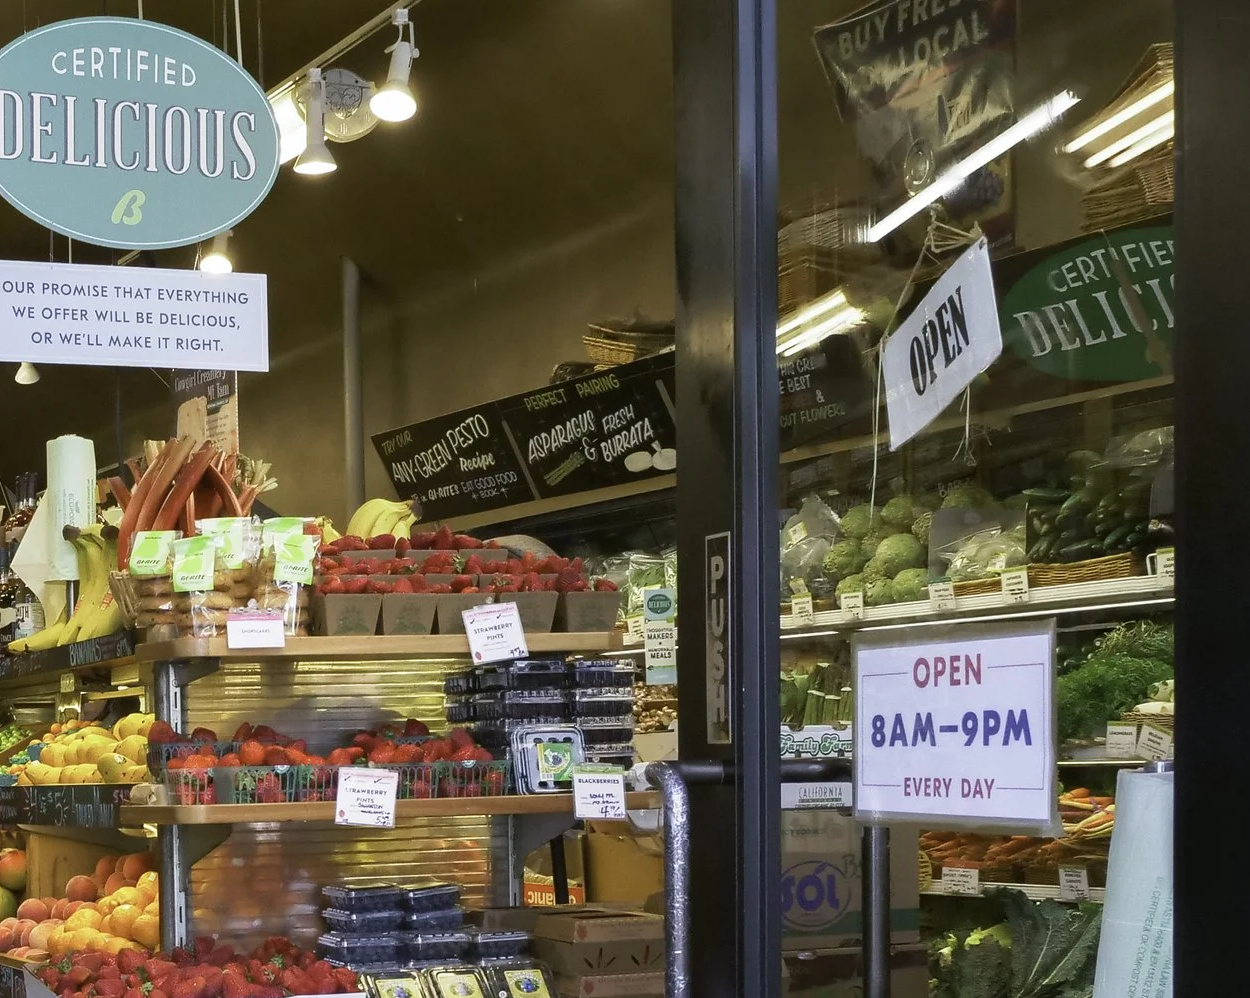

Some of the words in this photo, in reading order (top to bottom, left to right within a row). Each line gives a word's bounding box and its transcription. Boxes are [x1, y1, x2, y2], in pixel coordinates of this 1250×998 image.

[838, 11, 890, 60] BUY
[897, 0, 955, 33] FRE
[898, 11, 989, 67] LOCAL
[51, 47, 197, 87] CERTIFIED
[1048, 240, 1174, 293] CERTIFIE
[2, 280, 36, 294] OUR
[41, 282, 108, 298] PROMISE
[114, 286, 152, 300] THAT
[157, 288, 249, 305] EVERYTHING
[12, 305, 36, 319] WE
[41, 306, 89, 322] OFFER
[94, 309, 130, 324] WILL
[136, 311, 154, 325] BE
[159, 312, 241, 330] DELICIOUS,
[1012, 273, 1175, 358] DELICI
[31, 331, 53, 345] OR
[59, 332, 103, 347] WE'LL
[108, 334, 152, 349] MAKE
[157, 336, 170, 350] IT
[176, 337, 224, 352] RIGHT.
[909, 284, 970, 396] OPEN
[779, 361, 795, 376] HIS
[523, 388, 568, 412] PERFECT
[575, 373, 620, 398] PAIRING
[787, 374, 810, 393] BEST
[815, 389, 825, 403] &
[601, 403, 635, 435] FRESH
[446, 413, 489, 454] PESTO
[528, 409, 595, 464] ASPARAGUS
[582, 436, 597, 461] &
[600, 417, 654, 462] BURRATA
[381, 438, 396, 457] TRY
[459, 452, 496, 472] Recipe
[474, 476, 496, 490] GOOD
[495, 471, 518, 486] FOOD
[473, 622, 513, 634] STRAWBERRY
[486, 633, 504, 641] PINTS
[647, 632, 674, 640] MAKERS
[710, 556, 726, 723] PUSH
[650, 651, 672, 659] MEALS
[912, 652, 983, 690] OPEN
[798, 786, 843, 799] CALIFORNIA
[904, 776, 952, 799] EVERY
[961, 777, 996, 801] DAY
[527, 890, 577, 906] oanic
